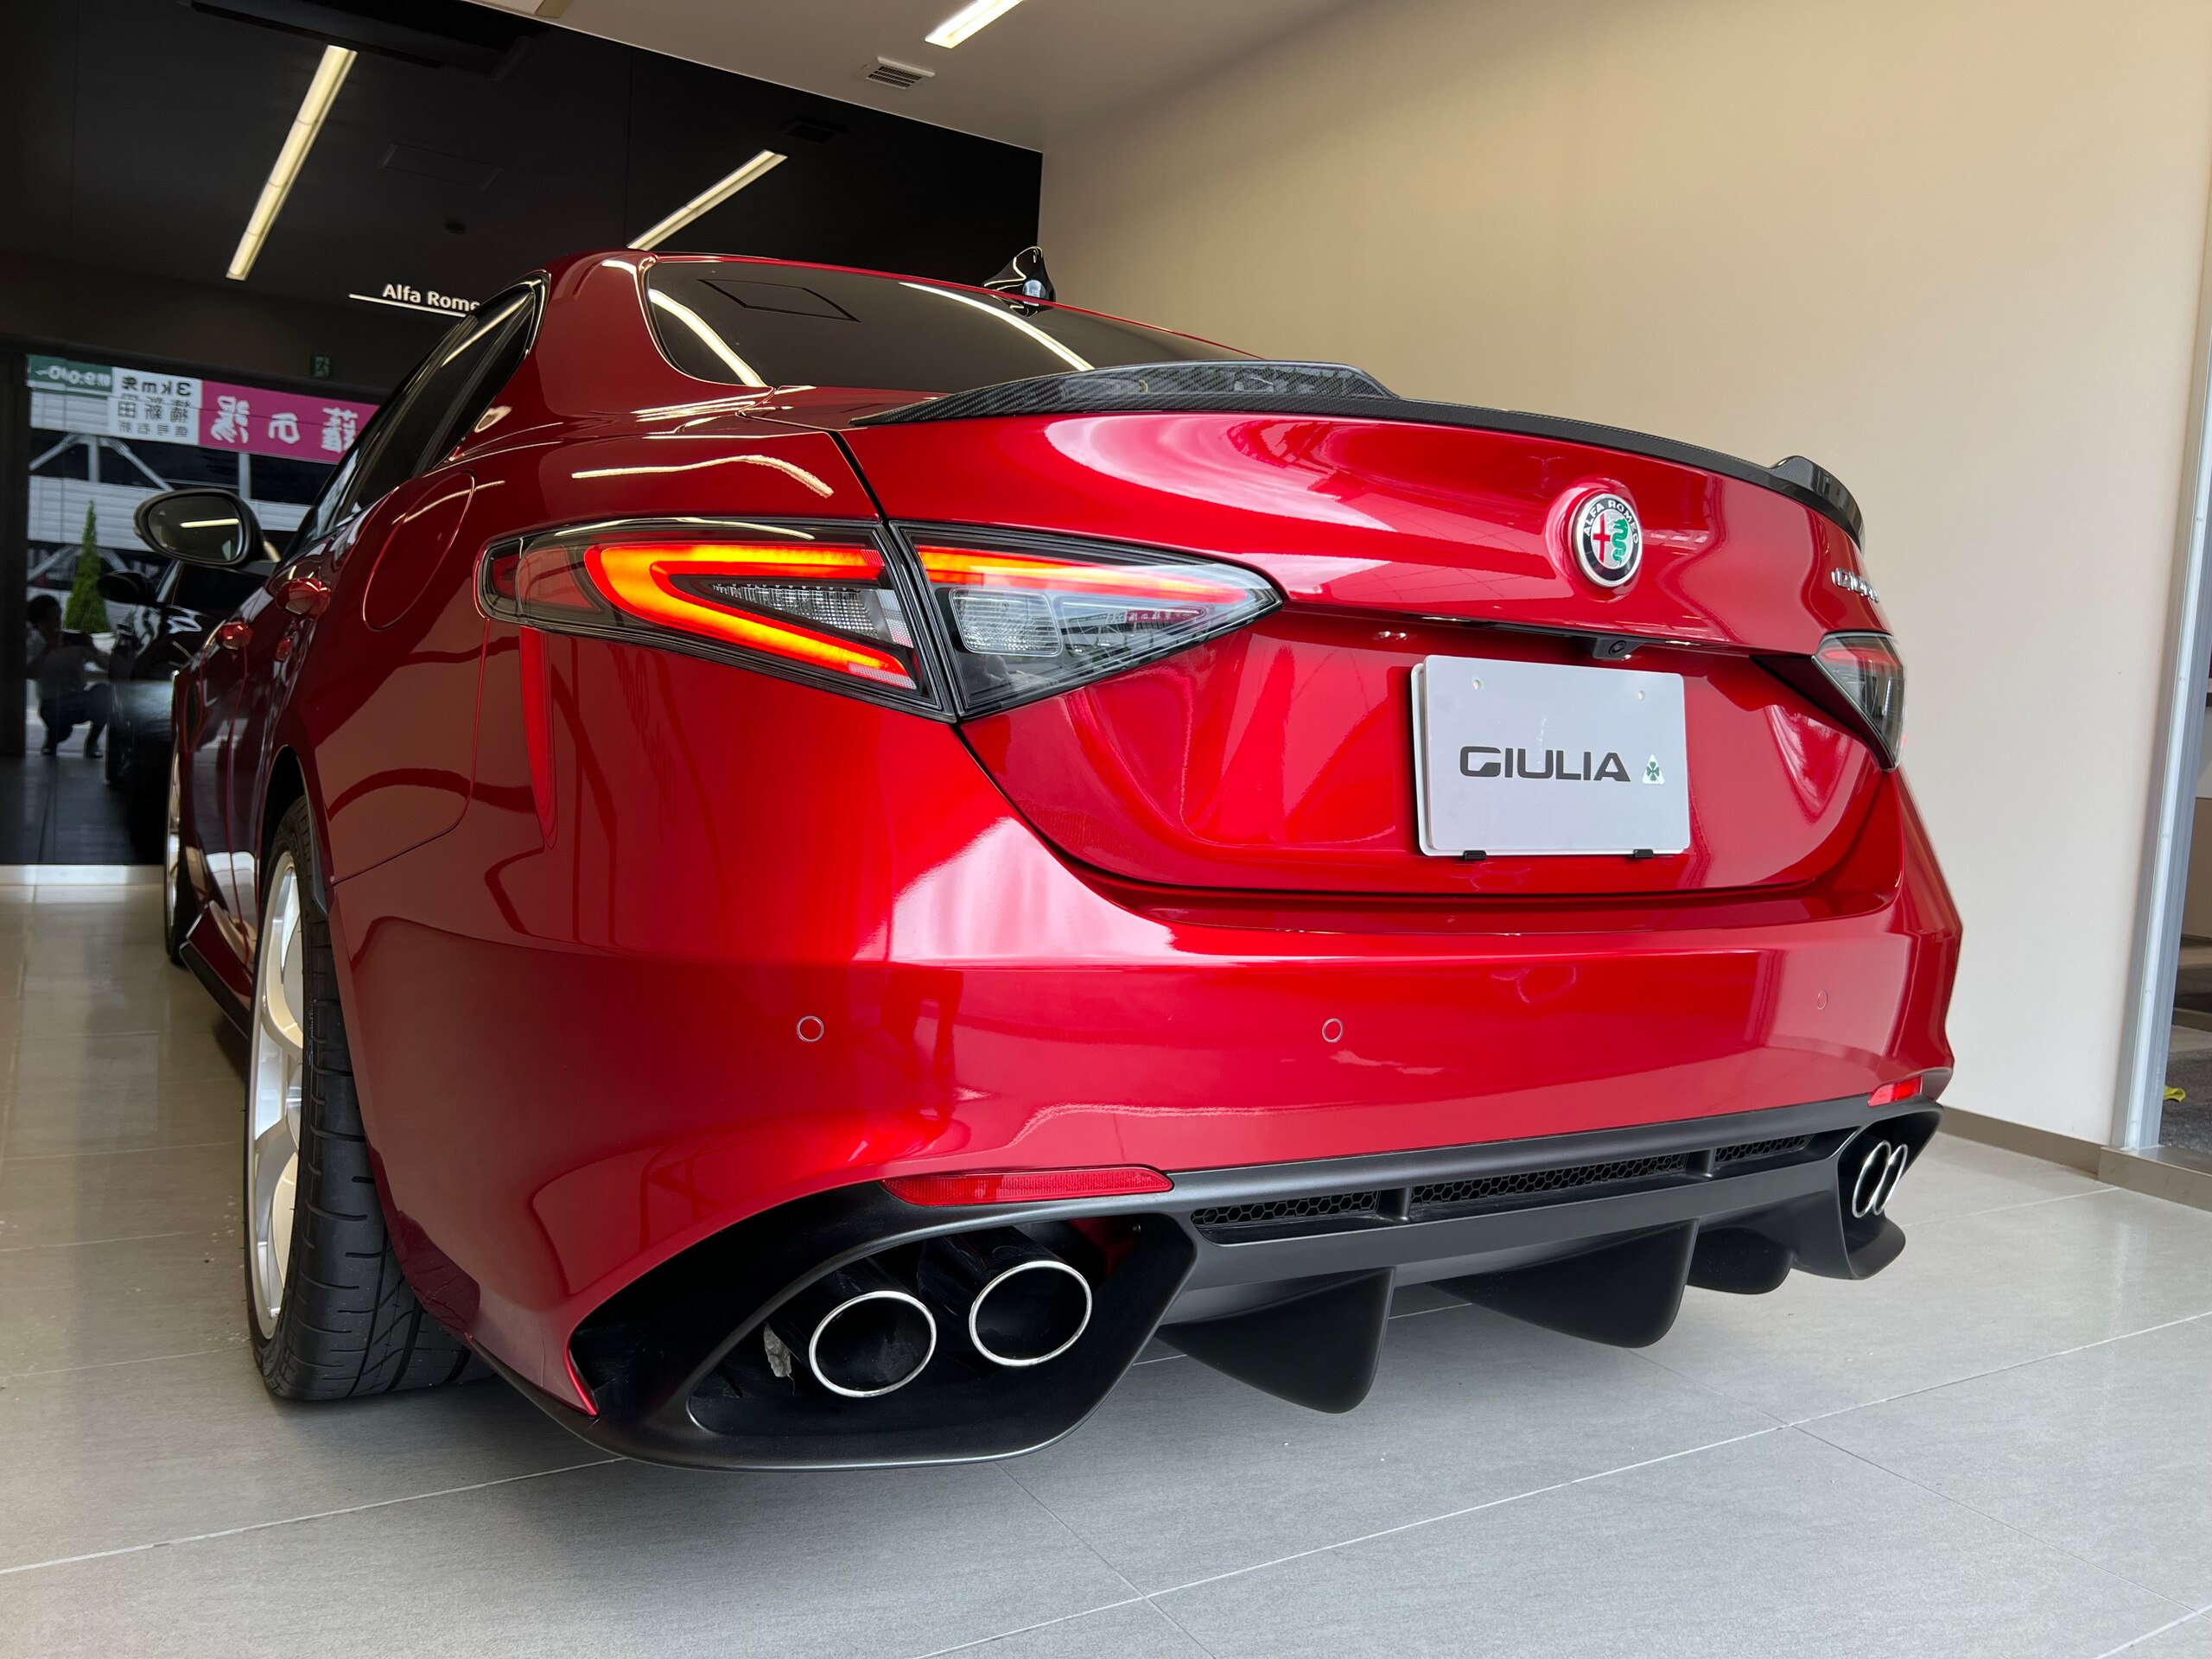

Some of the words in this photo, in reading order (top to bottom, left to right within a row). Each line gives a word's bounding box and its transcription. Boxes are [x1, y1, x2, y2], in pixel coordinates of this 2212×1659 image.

[383, 283, 422, 304] Alfa
[1583, 503, 1605, 537] ALFA
[1608, 499, 1639, 543] ROMEO
[1459, 746, 1630, 782] GIULIA
